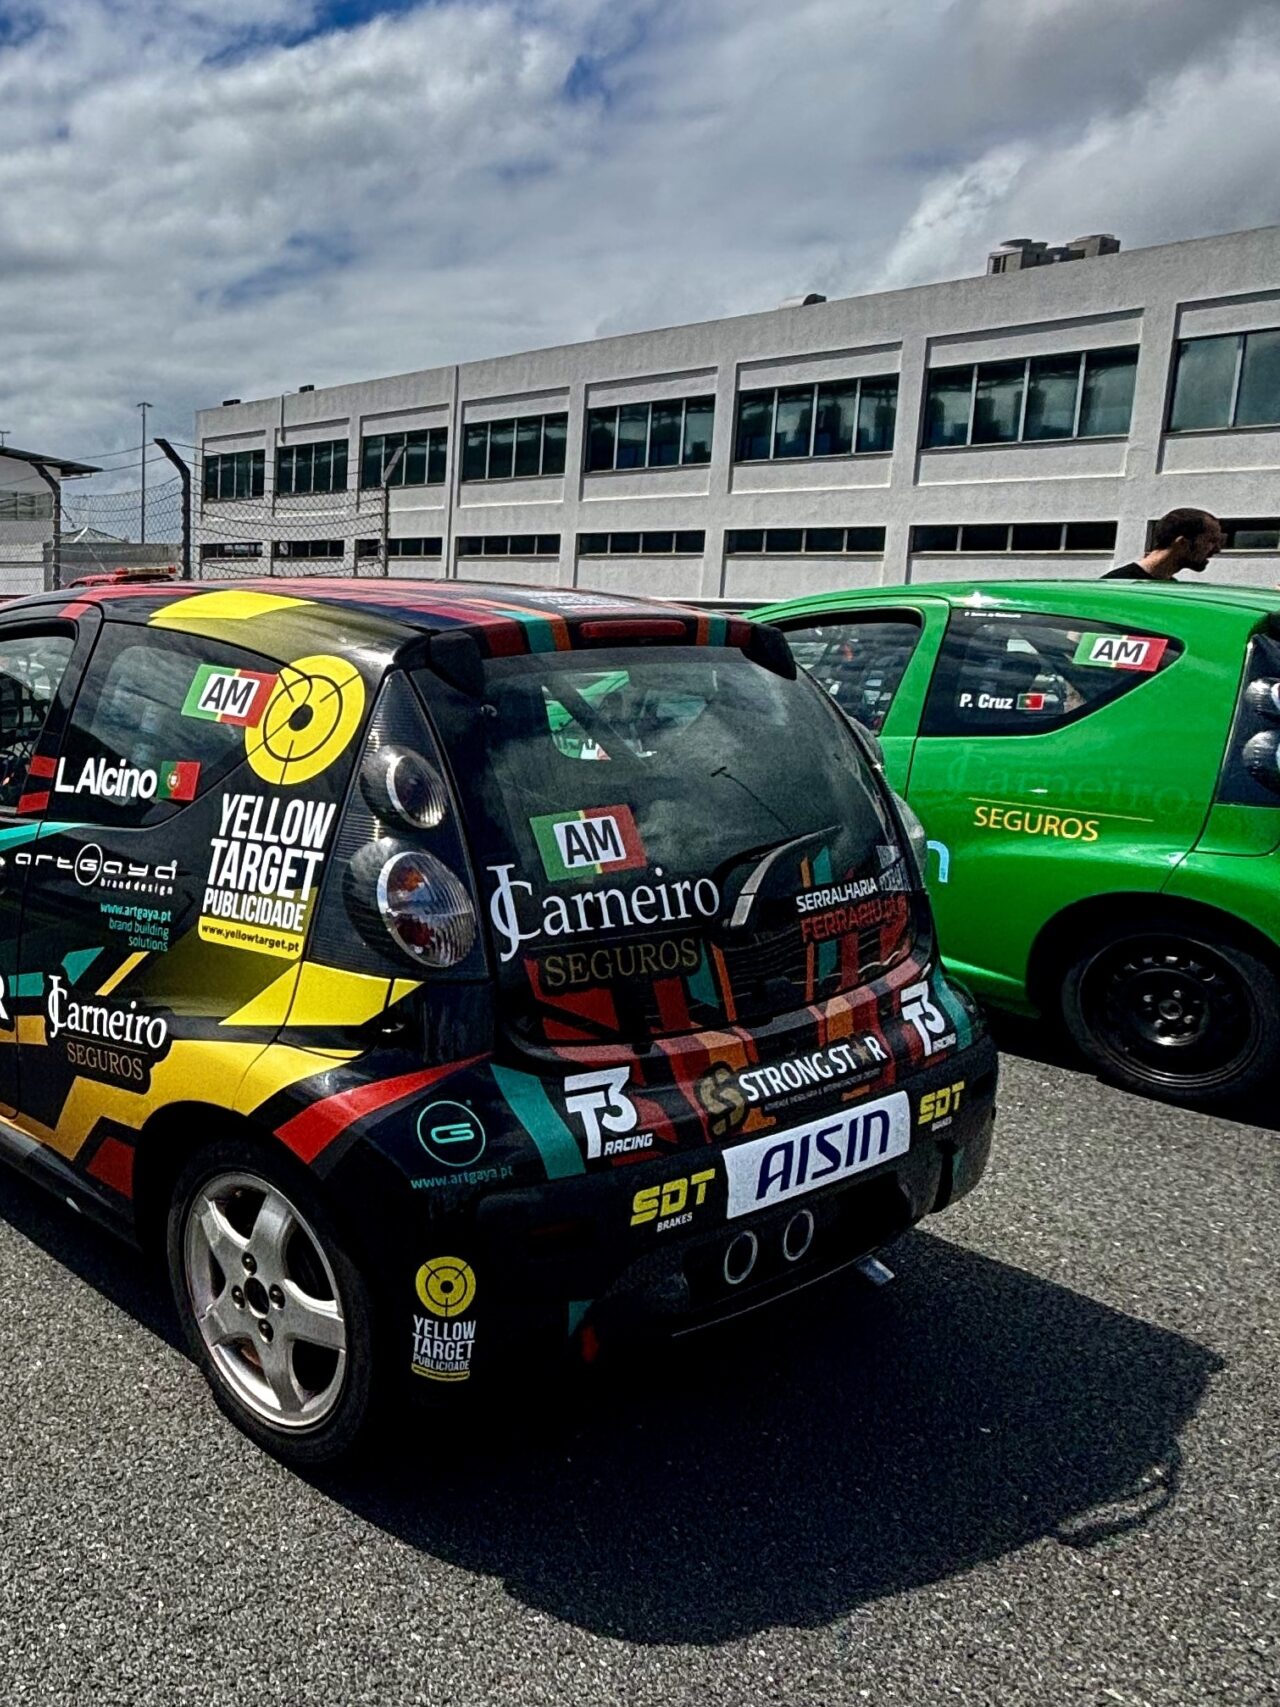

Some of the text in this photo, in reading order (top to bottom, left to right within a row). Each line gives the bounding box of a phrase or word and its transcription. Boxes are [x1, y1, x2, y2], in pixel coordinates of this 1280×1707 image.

[1092, 640, 1145, 663] AM
[201, 676, 255, 714] AM
[959, 693, 1014, 709] P. Cruz
[218, 793, 337, 849] YELLOW
[973, 806, 1100, 842] SEGUROS
[564, 819, 621, 865] AM
[100, 877, 174, 896] brand design
[207, 838, 325, 902] TARGET
[100, 903, 172, 923] www.artgaya.pt
[202, 887, 307, 932] PUBLICIDADE
[796, 877, 879, 914] SERRALHARIA
[109, 917, 169, 941] brand building
[128, 935, 169, 952] solutions
[202, 924, 300, 952] www.yellowtarget.pt
[545, 937, 699, 987] SEGUROS
[901, 981, 946, 1057] T3
[66, 1041, 144, 1081] SEGUROS
[739, 1052, 834, 1102] STRONG
[564, 1066, 638, 1160] T3
[918, 1080, 965, 1126] SDT
[604, 1133, 653, 1156] RACING
[755, 1109, 890, 1201] AISIN
[410, 1165, 513, 1190] www.artgaya.pt
[630, 1168, 716, 1227] SDT
[656, 1212, 693, 1233] BRAKES
[413, 1314, 477, 1341] YELLOW
[412, 1332, 476, 1361] TARGET
[413, 1352, 470, 1371] PUBLICIDADE
